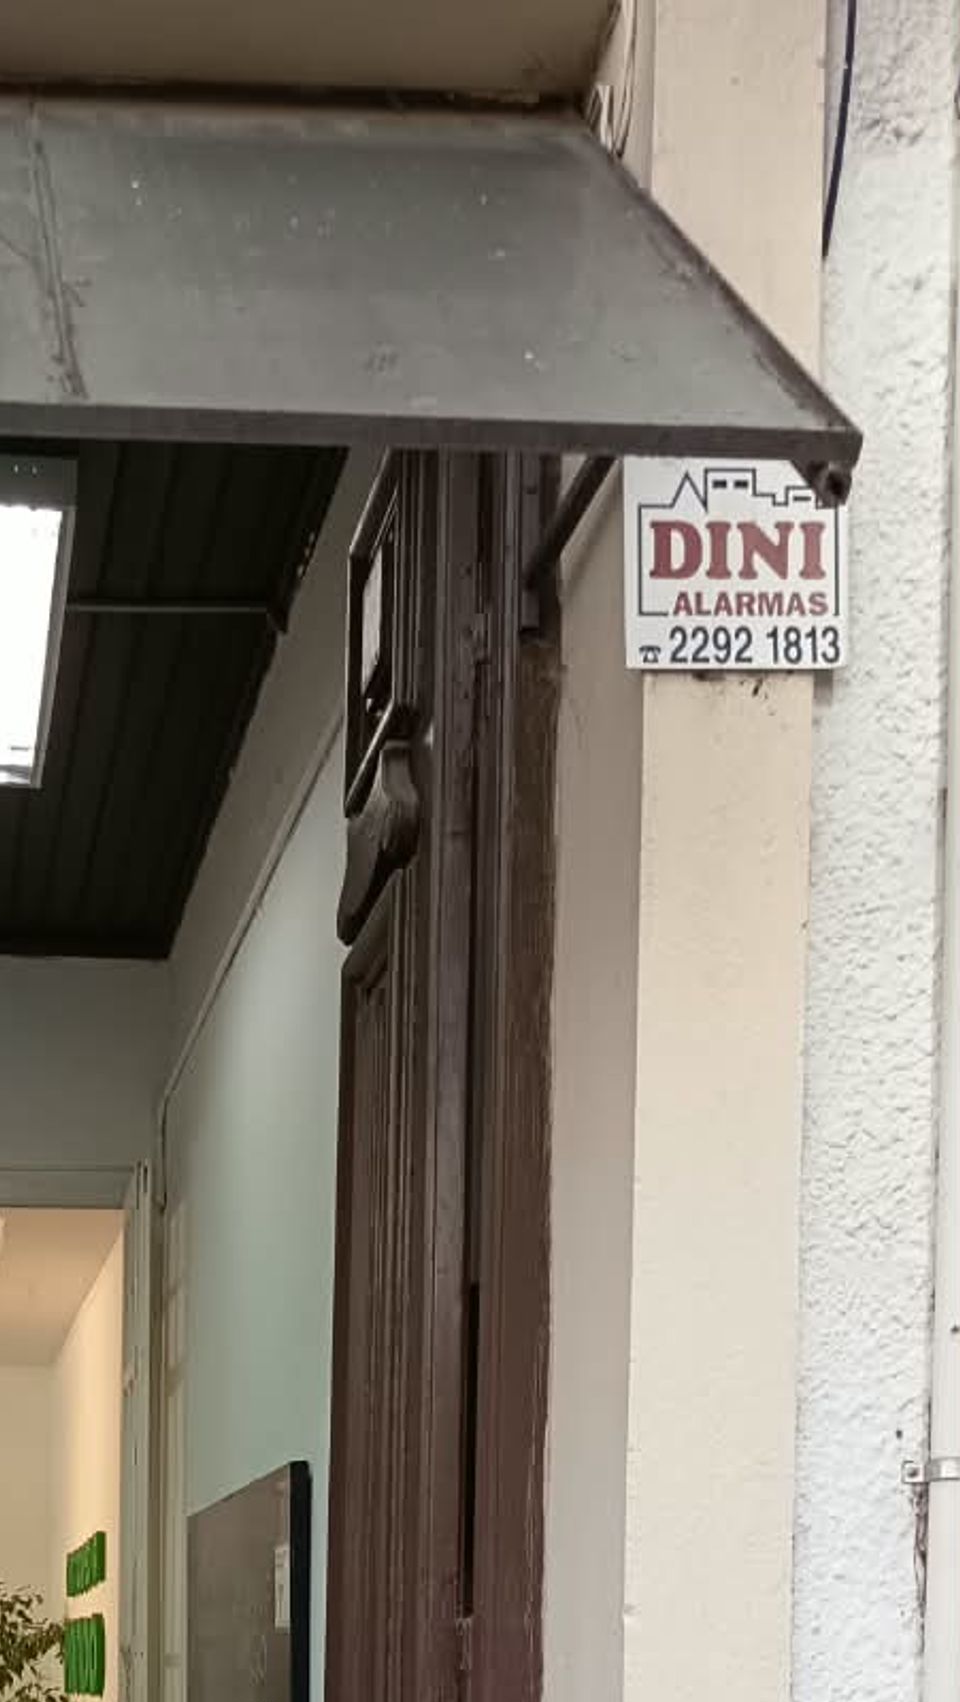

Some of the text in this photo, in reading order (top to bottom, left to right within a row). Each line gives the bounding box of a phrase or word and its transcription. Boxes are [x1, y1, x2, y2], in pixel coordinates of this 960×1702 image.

[648, 519, 827, 580] DINI
[672, 591, 829, 617] ALARMAS
[669, 625, 841, 664] 2292 1813
